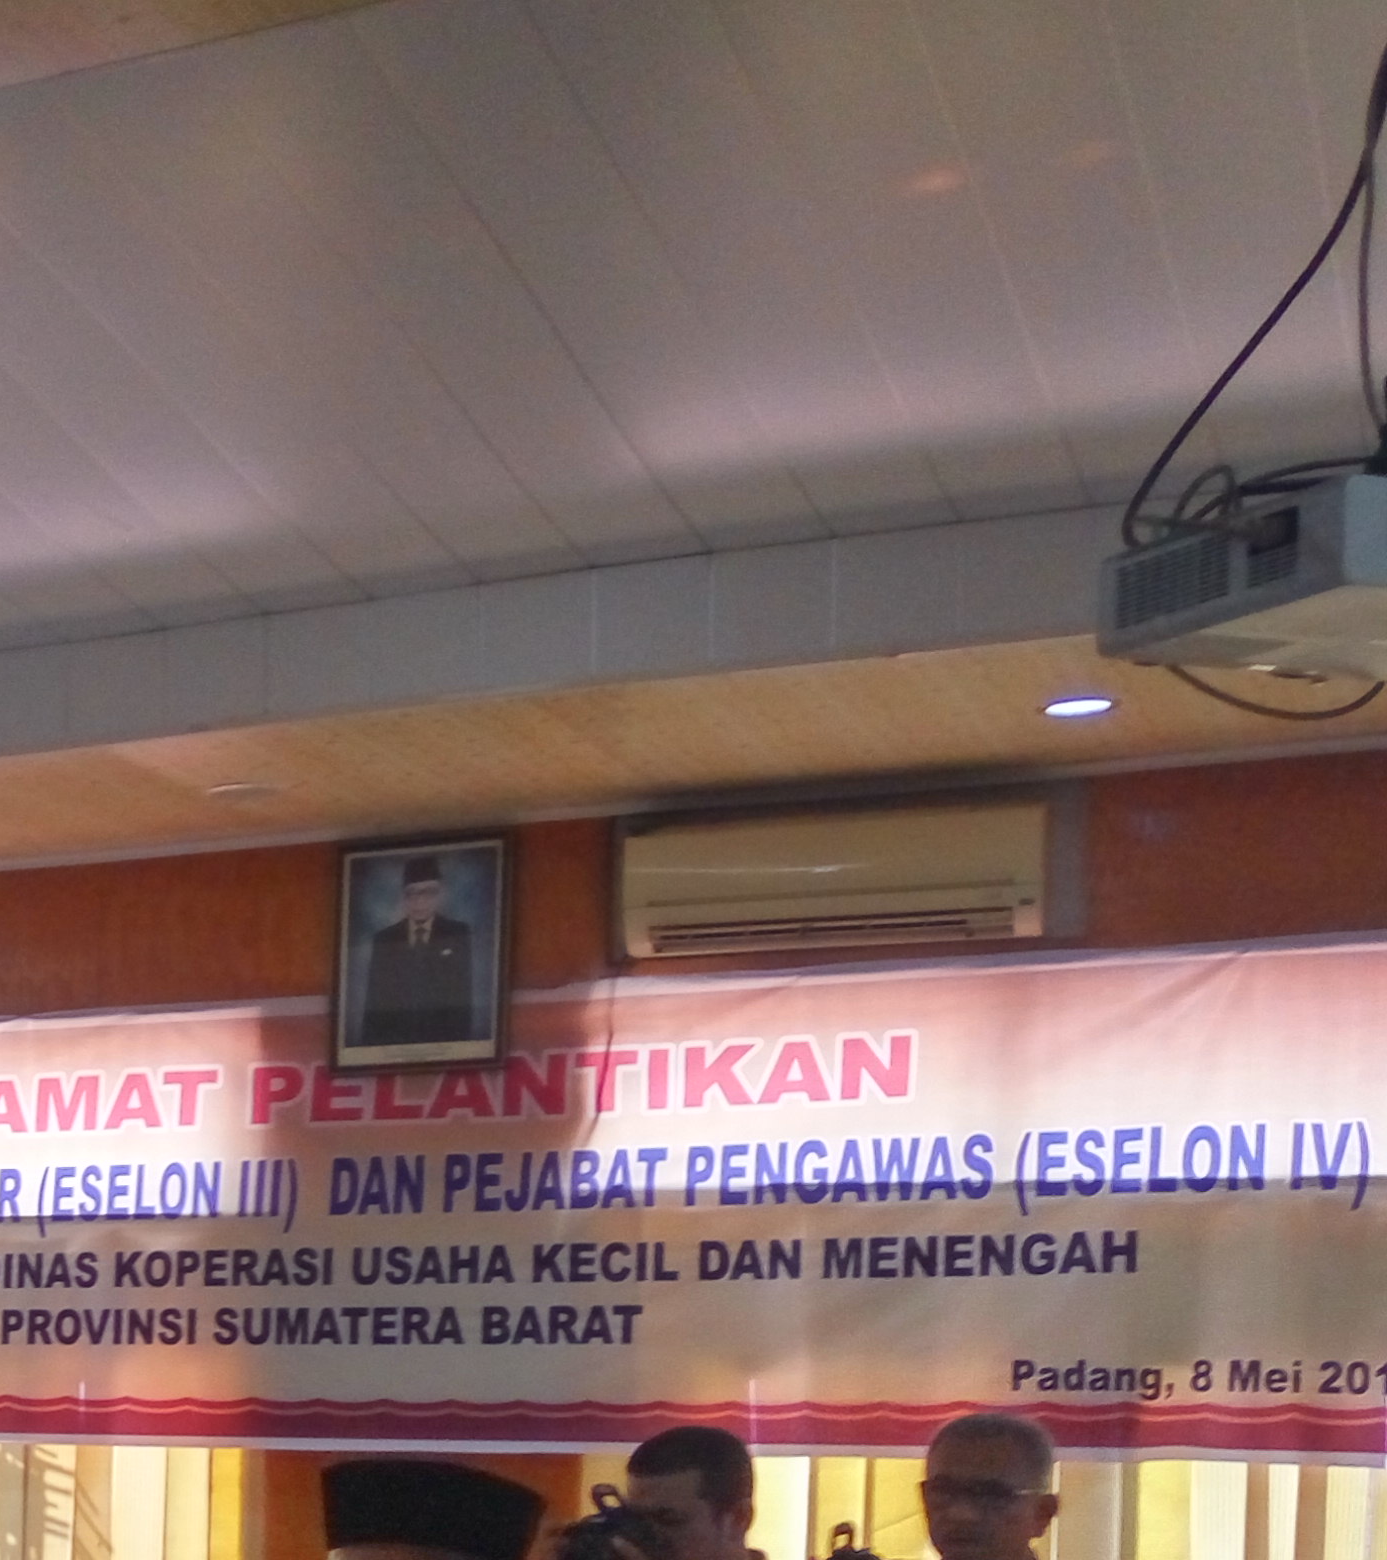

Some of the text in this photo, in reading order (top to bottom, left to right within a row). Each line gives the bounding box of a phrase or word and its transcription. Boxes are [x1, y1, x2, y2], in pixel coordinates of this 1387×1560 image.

[250, 1035, 912, 1125] PELANTIKAN
[38, 1161, 222, 1238] (ESELON
[238, 1158, 298, 1234] III)
[329, 1154, 425, 1216] DAN
[443, 1147, 667, 1213] PEJABAT
[684, 1133, 993, 1206] PENGAWAS
[1016, 1123, 1266, 1216] (ESELON
[1290, 1121, 1370, 1211] IV)
[114, 1246, 333, 1288] KOPERASI
[353, 1244, 515, 1285] USAHA
[532, 1241, 679, 1283] KECIL
[699, 1239, 802, 1281] DAN
[822, 1230, 1139, 1279] MENENGAH
[1, 1304, 643, 1345] PROVINSI SUMATERA BARAT
[1011, 1359, 1175, 1400] Padang,
[1189, 1360, 1213, 1392] 8
[1228, 1360, 1303, 1393] Mei
